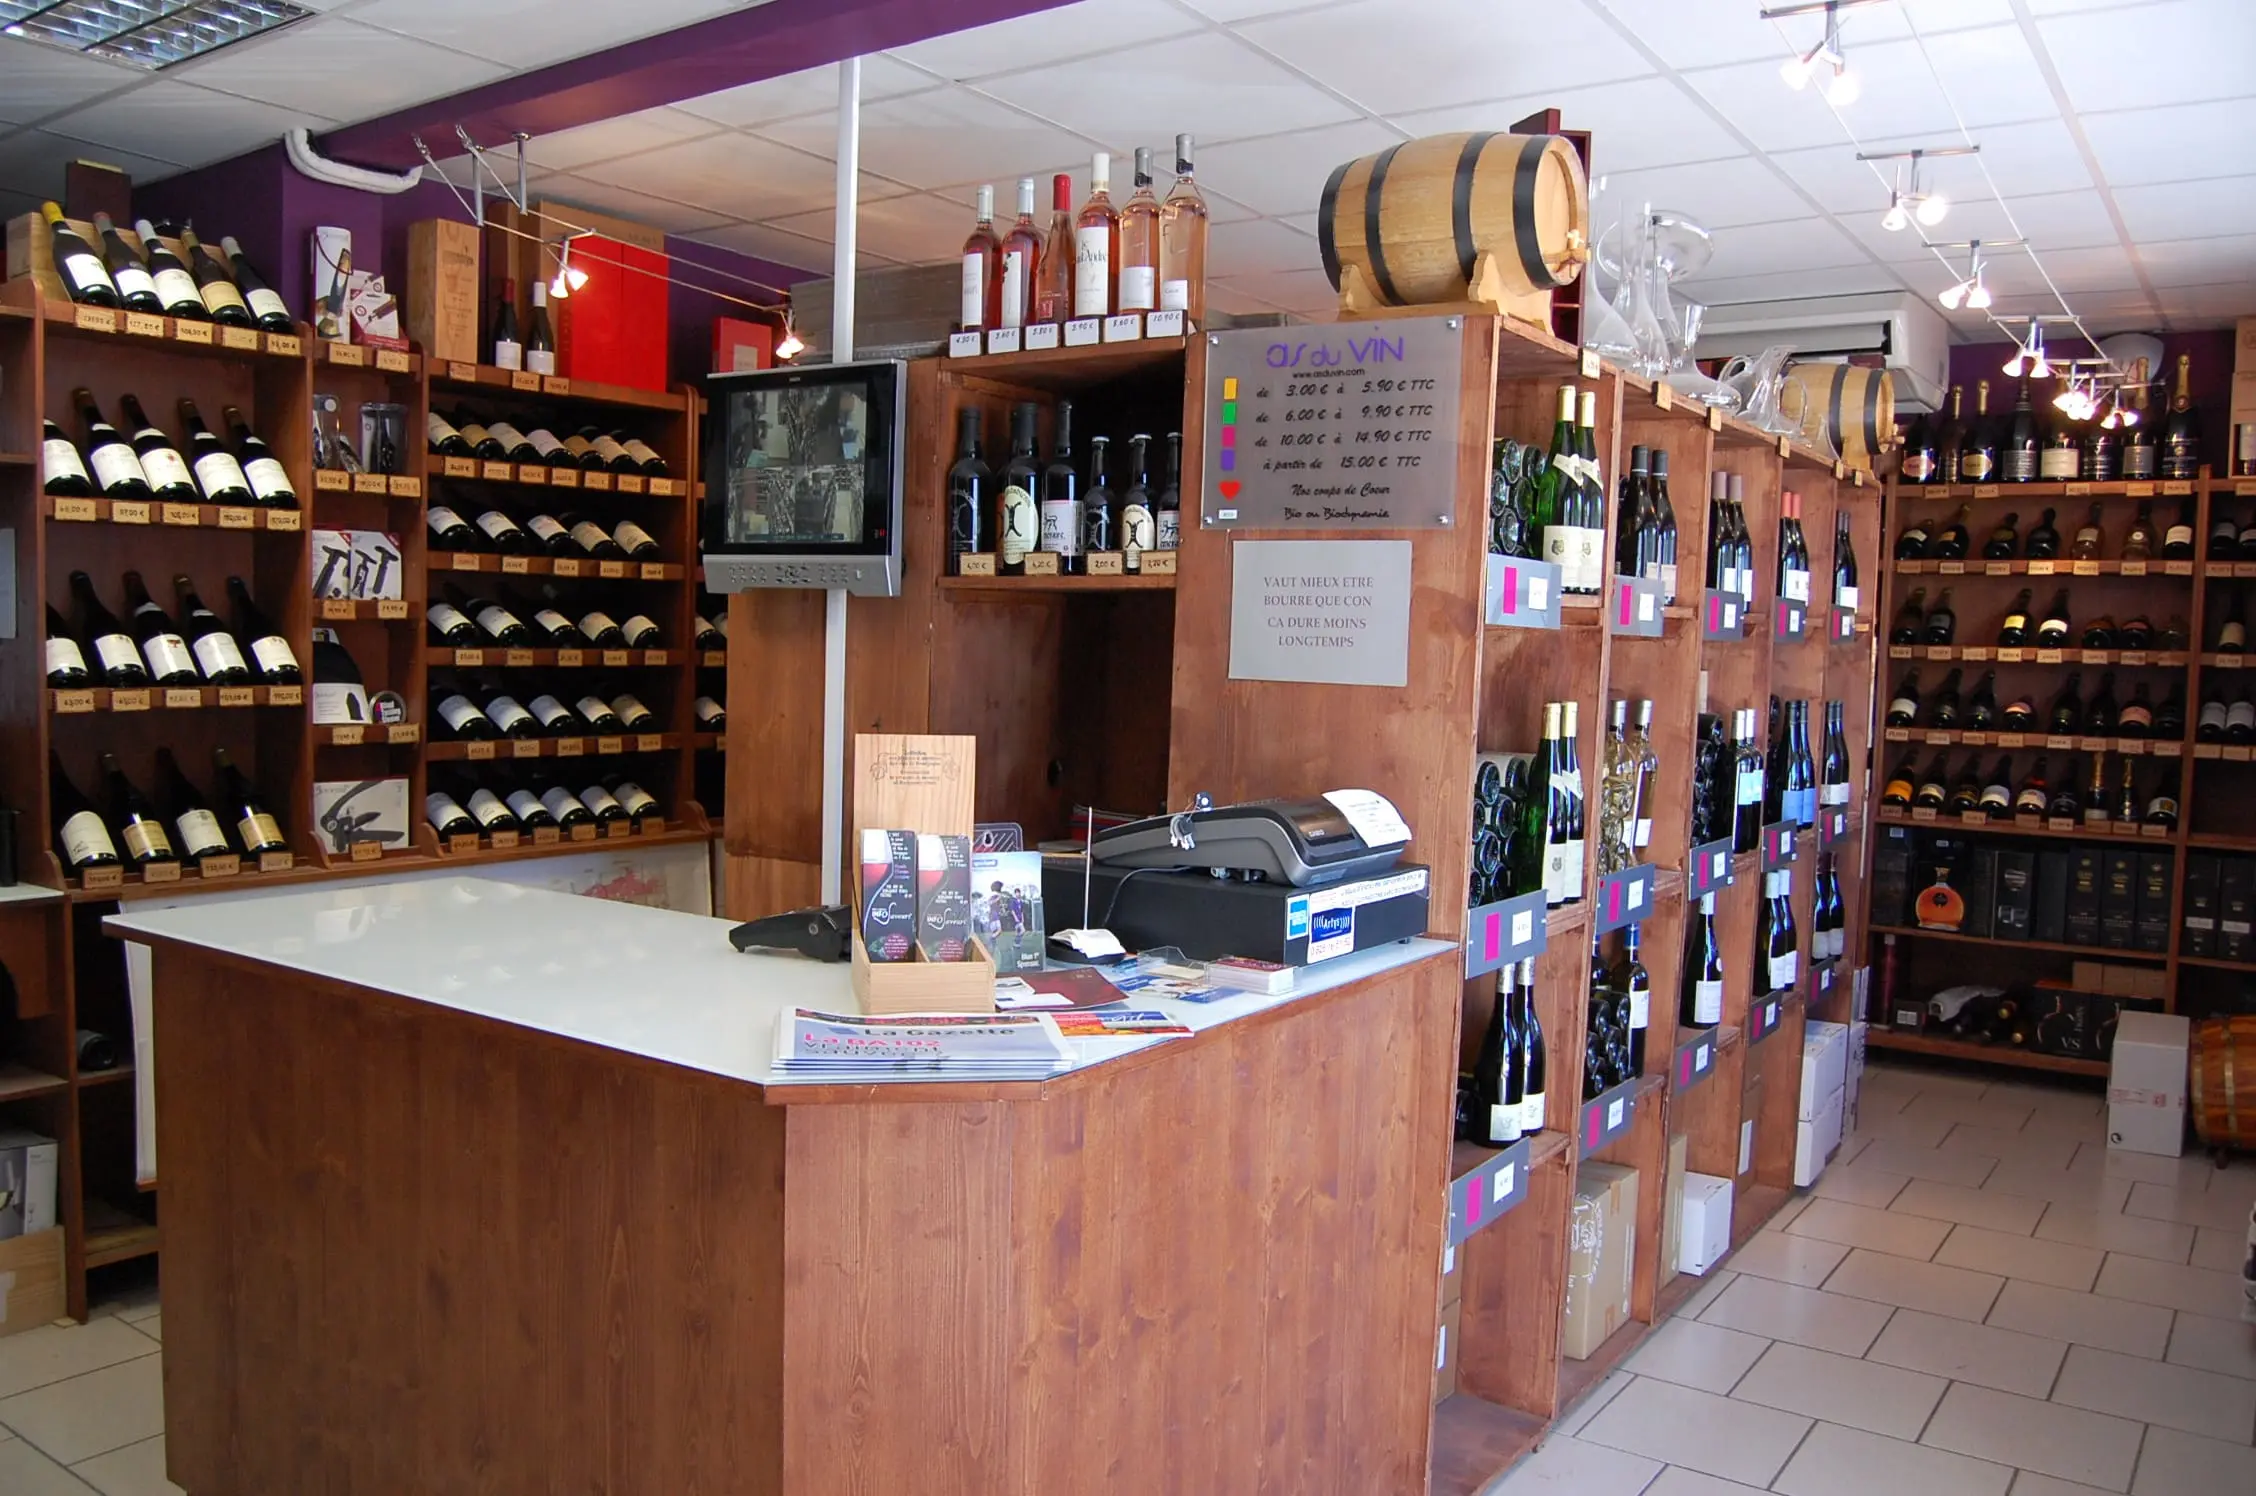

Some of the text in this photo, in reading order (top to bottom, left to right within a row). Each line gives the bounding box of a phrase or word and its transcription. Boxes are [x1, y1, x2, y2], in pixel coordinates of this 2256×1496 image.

[1311, 344, 1342, 367] du
[1292, 367, 1366, 379] www.asduvin.com
[1256, 379, 1436, 399] de 3.00 € à 5.90 € TTC
[1255, 405, 1433, 423] de 6.00 € à 9.90 € TTC
[1254, 430, 1432, 448] de 10.00 € à 14.90 € TTC
[1263, 455, 1421, 473] à partir de 15.00 € TTC
[1314, 485, 1341, 499] coups
[1344, 483, 1357, 496] de
[1284, 506, 1390, 521] Bio ou Biodynamie
[1263, 576, 1374, 588] VAUT MIEUX ETRE
[1263, 595, 1373, 608] BOURRE QUE CON
[1267, 616, 1367, 629] CA DURE MOINS
[1278, 636, 1355, 647] LONGTEMPS
[804, 1033, 839, 1045] La
[864, 1028, 1016, 1037] La Gazette
